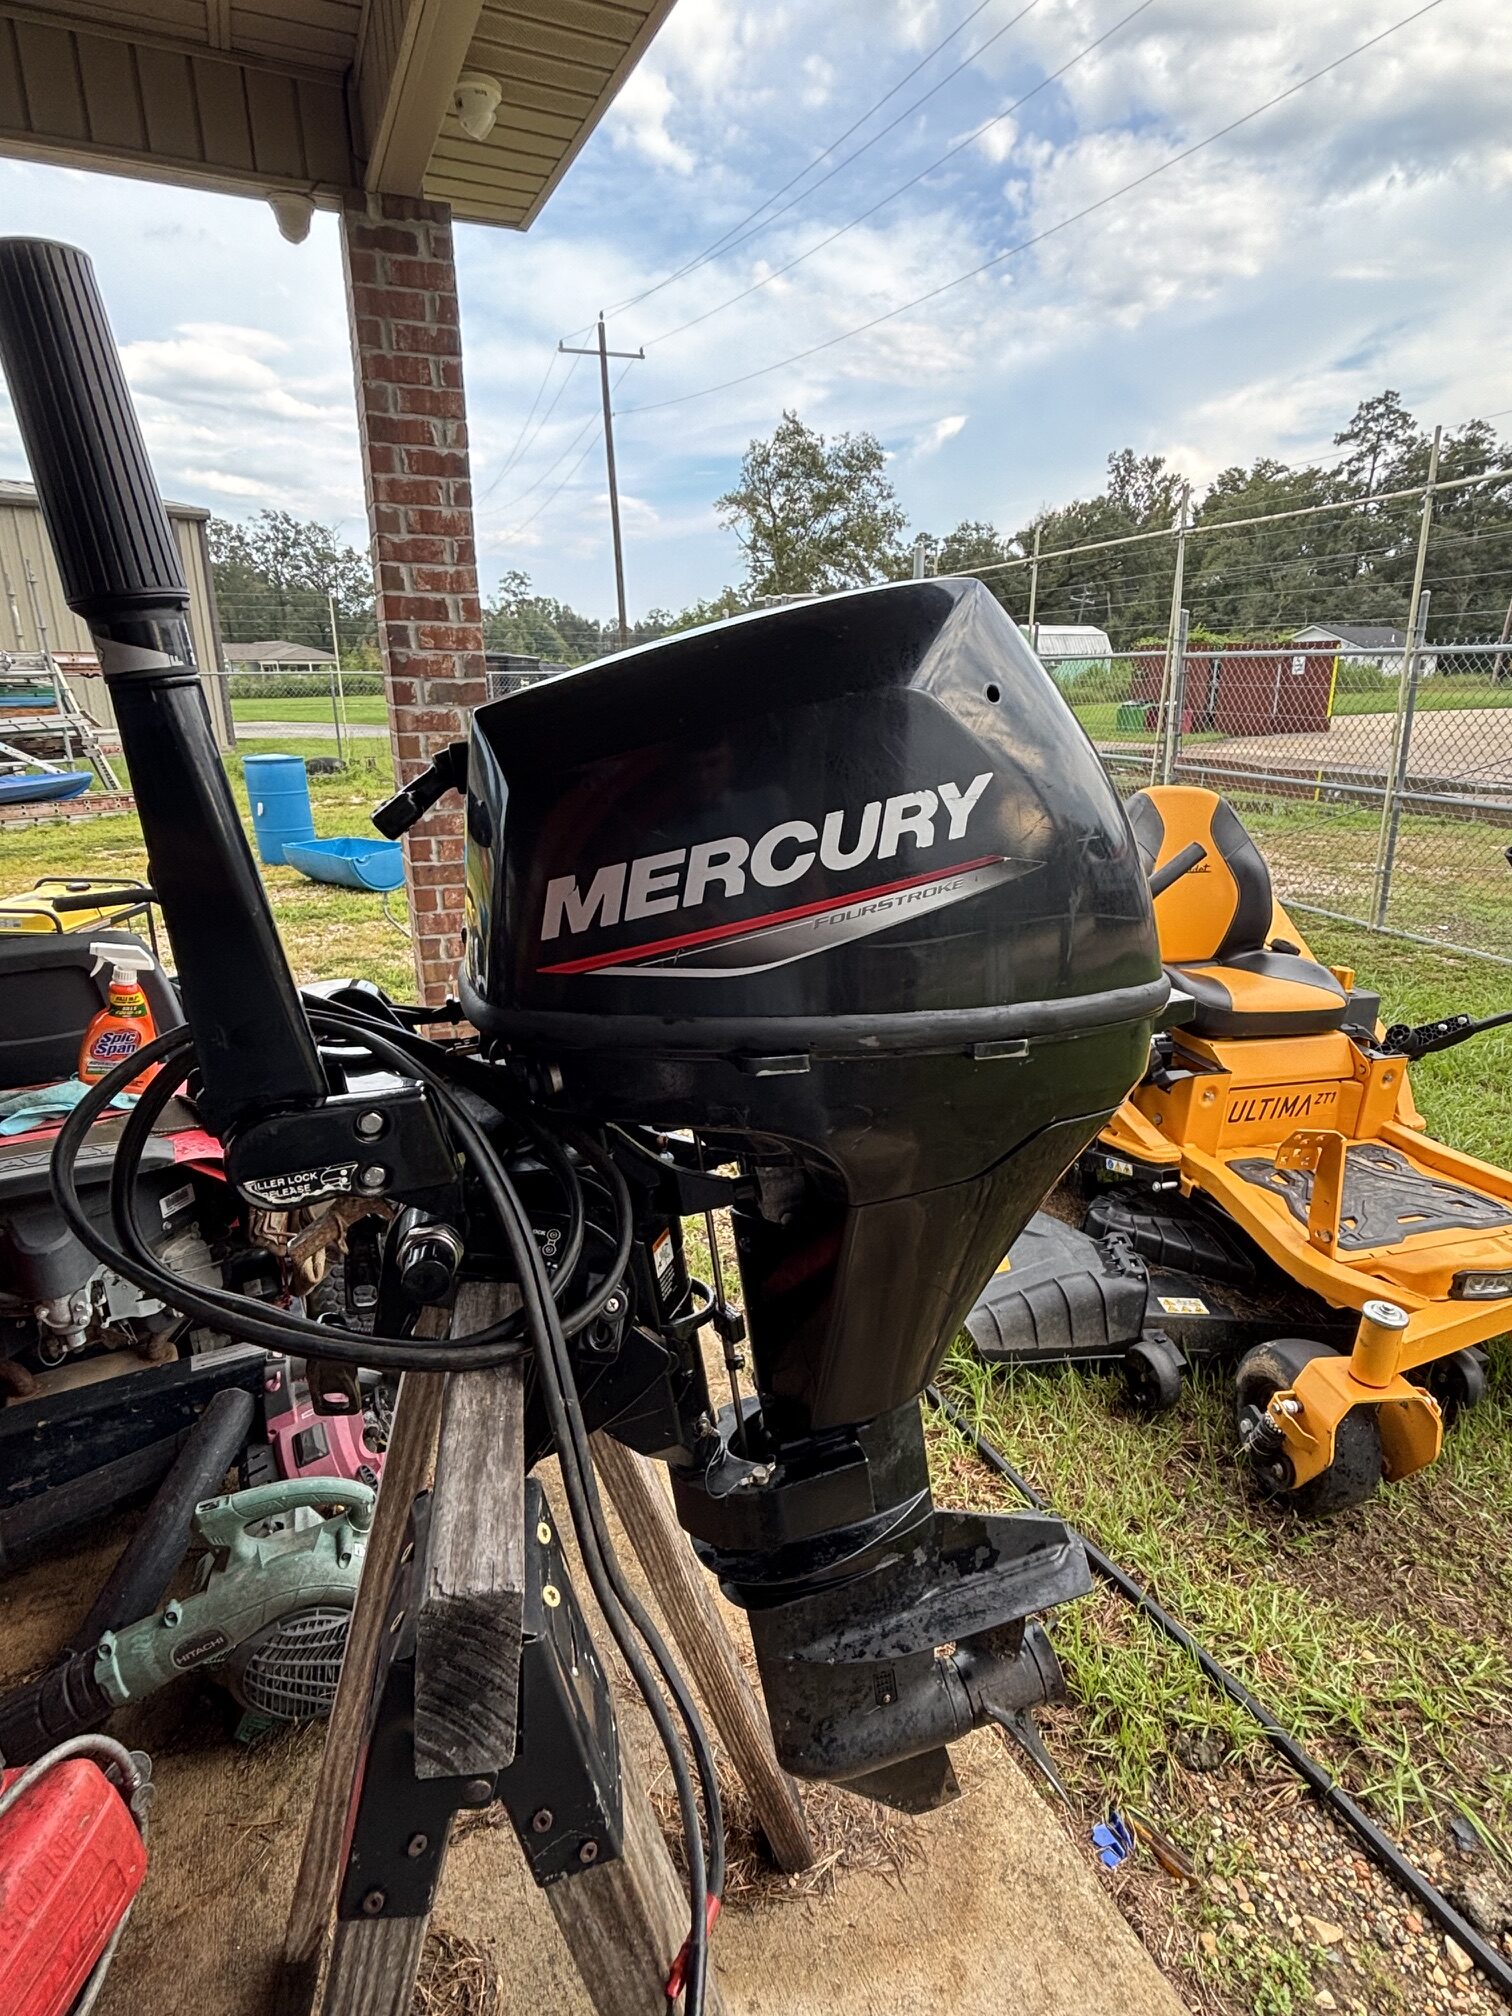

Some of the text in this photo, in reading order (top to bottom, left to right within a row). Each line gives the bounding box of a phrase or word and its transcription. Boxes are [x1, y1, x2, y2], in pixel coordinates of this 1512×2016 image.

[541, 772, 994, 941] MERCURY
[813, 878, 964, 930] FOURSTROKE
[94, 1043, 136, 1057] Span
[101, 1032, 135, 1045] Spic
[1228, 1091, 1337, 1123] ULTIMA ZT1
[249, 1171, 318, 1192] ILLER LOCK
[176, 1636, 225, 1665] HITACHI
